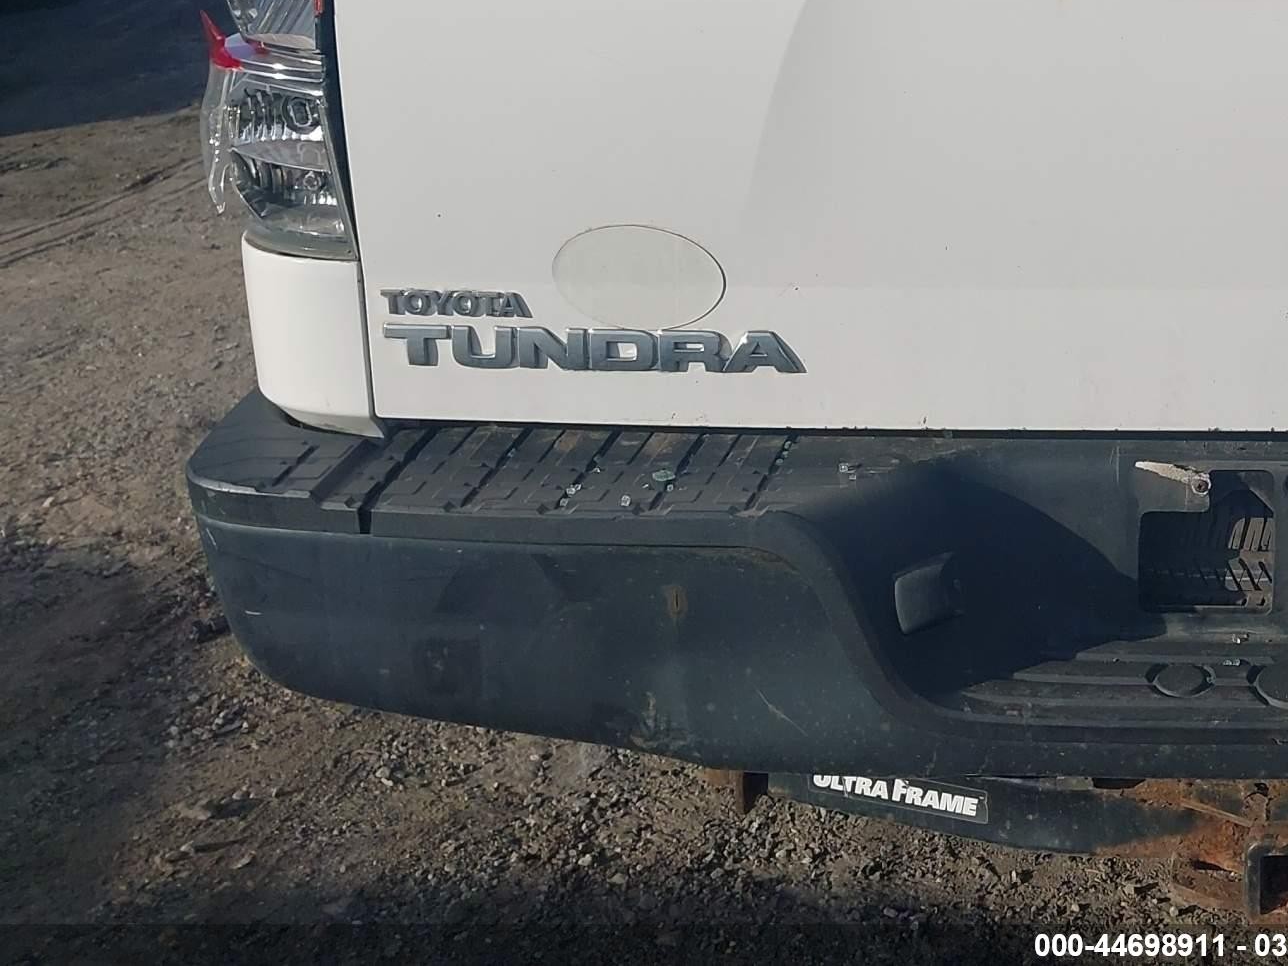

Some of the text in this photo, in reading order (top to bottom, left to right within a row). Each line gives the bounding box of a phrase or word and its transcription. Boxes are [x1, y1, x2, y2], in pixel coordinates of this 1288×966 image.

[380, 288, 533, 318] TOYOTA
[383, 323, 808, 373] TUNDRA
[813, 774, 979, 816] ULTRA FRAME
